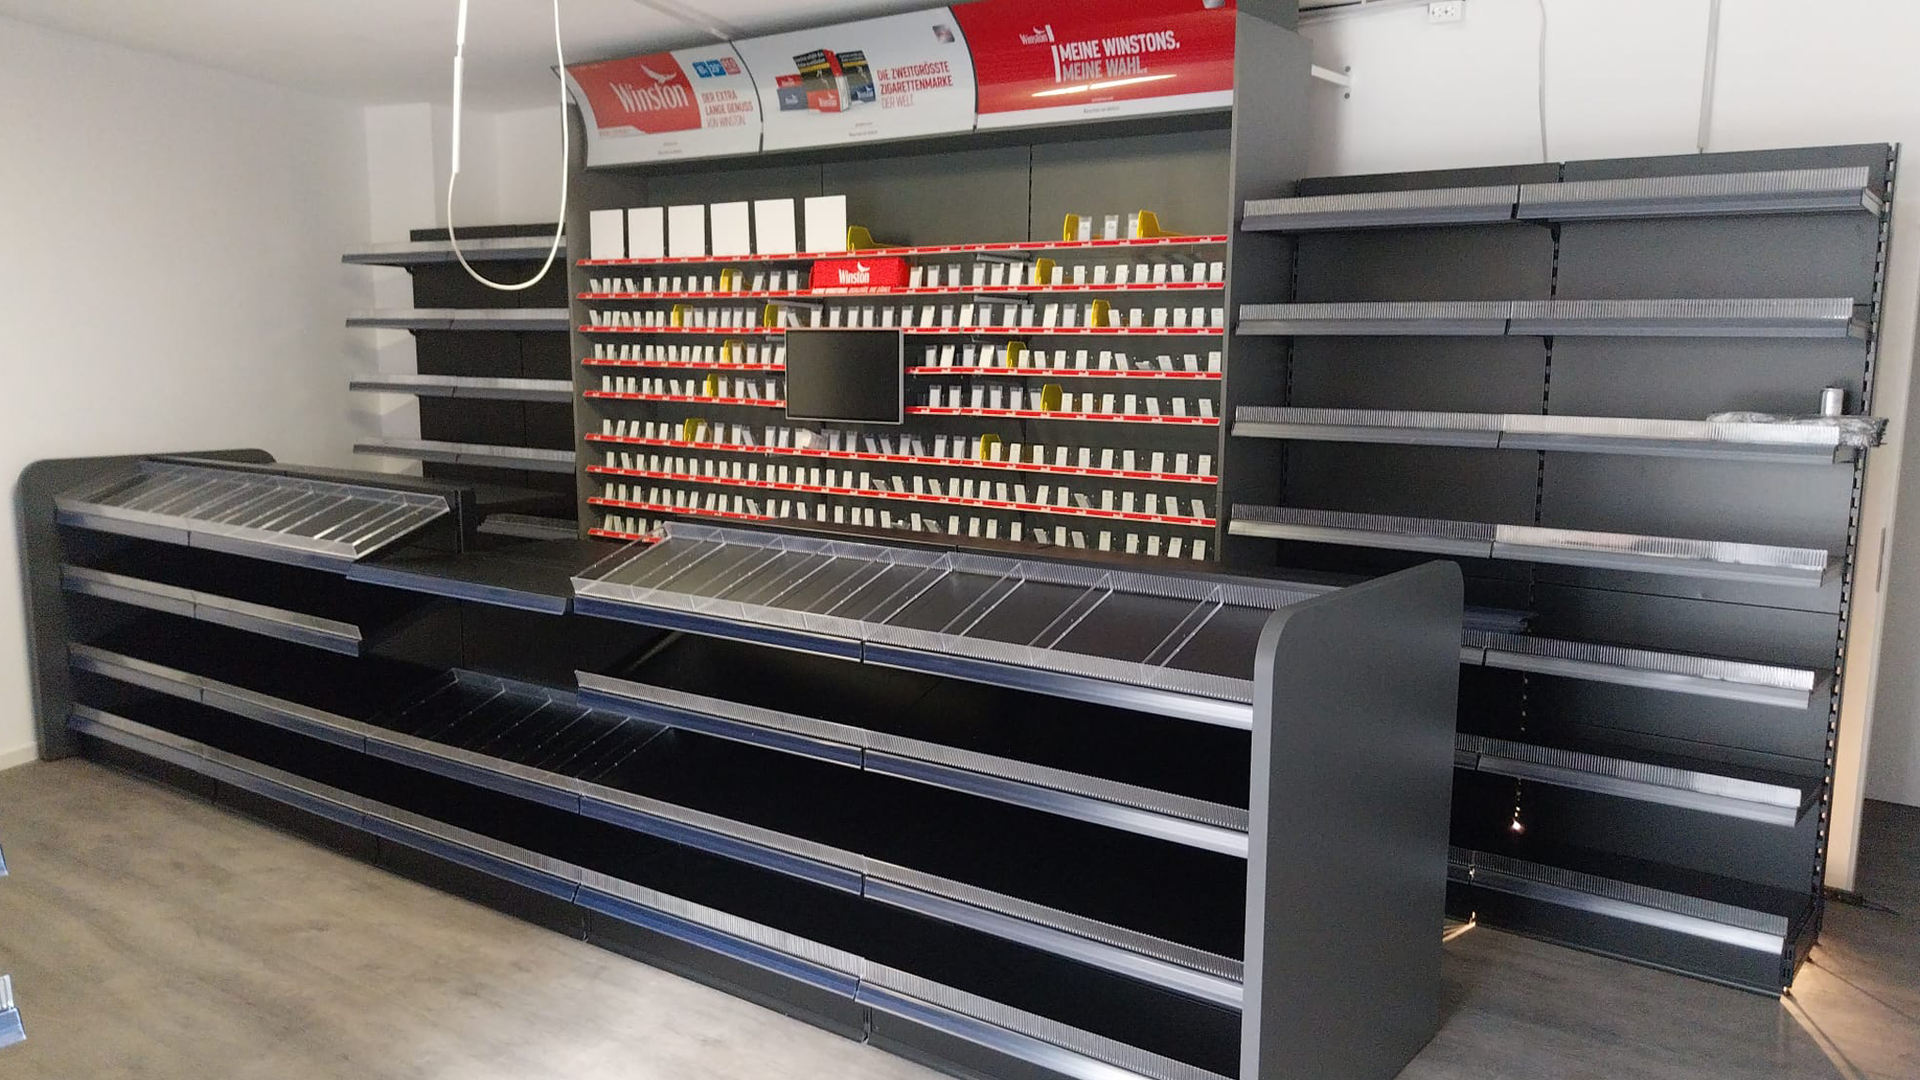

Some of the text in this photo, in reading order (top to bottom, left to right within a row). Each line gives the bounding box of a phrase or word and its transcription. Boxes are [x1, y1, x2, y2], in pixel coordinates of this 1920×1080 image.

[1019, 32, 1048, 45] Winston
[1058, 30, 1180, 62] MEINE WINSTONS.
[877, 61, 949, 81] DIE ZWEITGRÖSSTE
[1062, 55, 1148, 81] MEINE WAHL.
[879, 74, 953, 95] ZIGARETTENMARKE
[609, 82, 689, 113] Winston
[715, 90, 737, 102] EXTRA
[881, 94, 914, 109] DER WELT
[705, 104, 726, 115] LANGE
[838, 269, 870, 284] Winston
